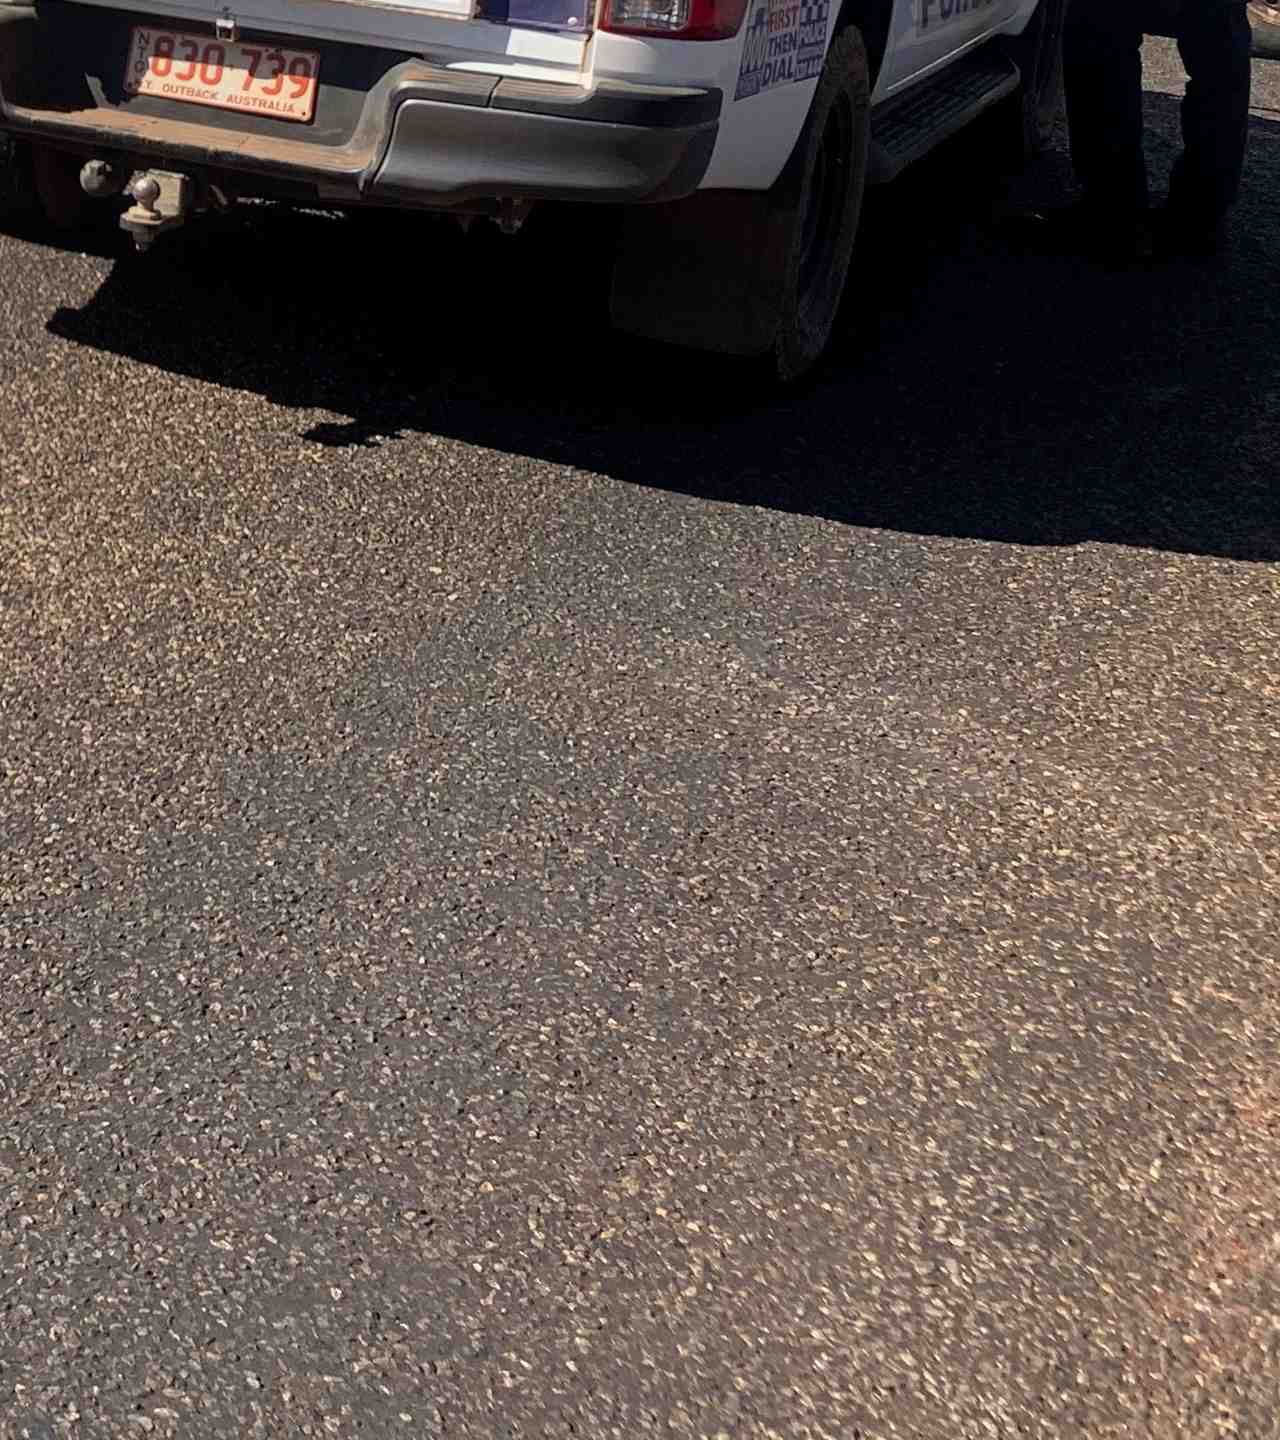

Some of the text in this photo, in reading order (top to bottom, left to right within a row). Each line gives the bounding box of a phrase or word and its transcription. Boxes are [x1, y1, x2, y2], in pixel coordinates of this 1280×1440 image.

[768, 31, 798, 57] THEN
[760, 55, 794, 87] DIAL
[161, 82, 219, 101] OUTBACK
[226, 94, 297, 114] AUSTRALIA
